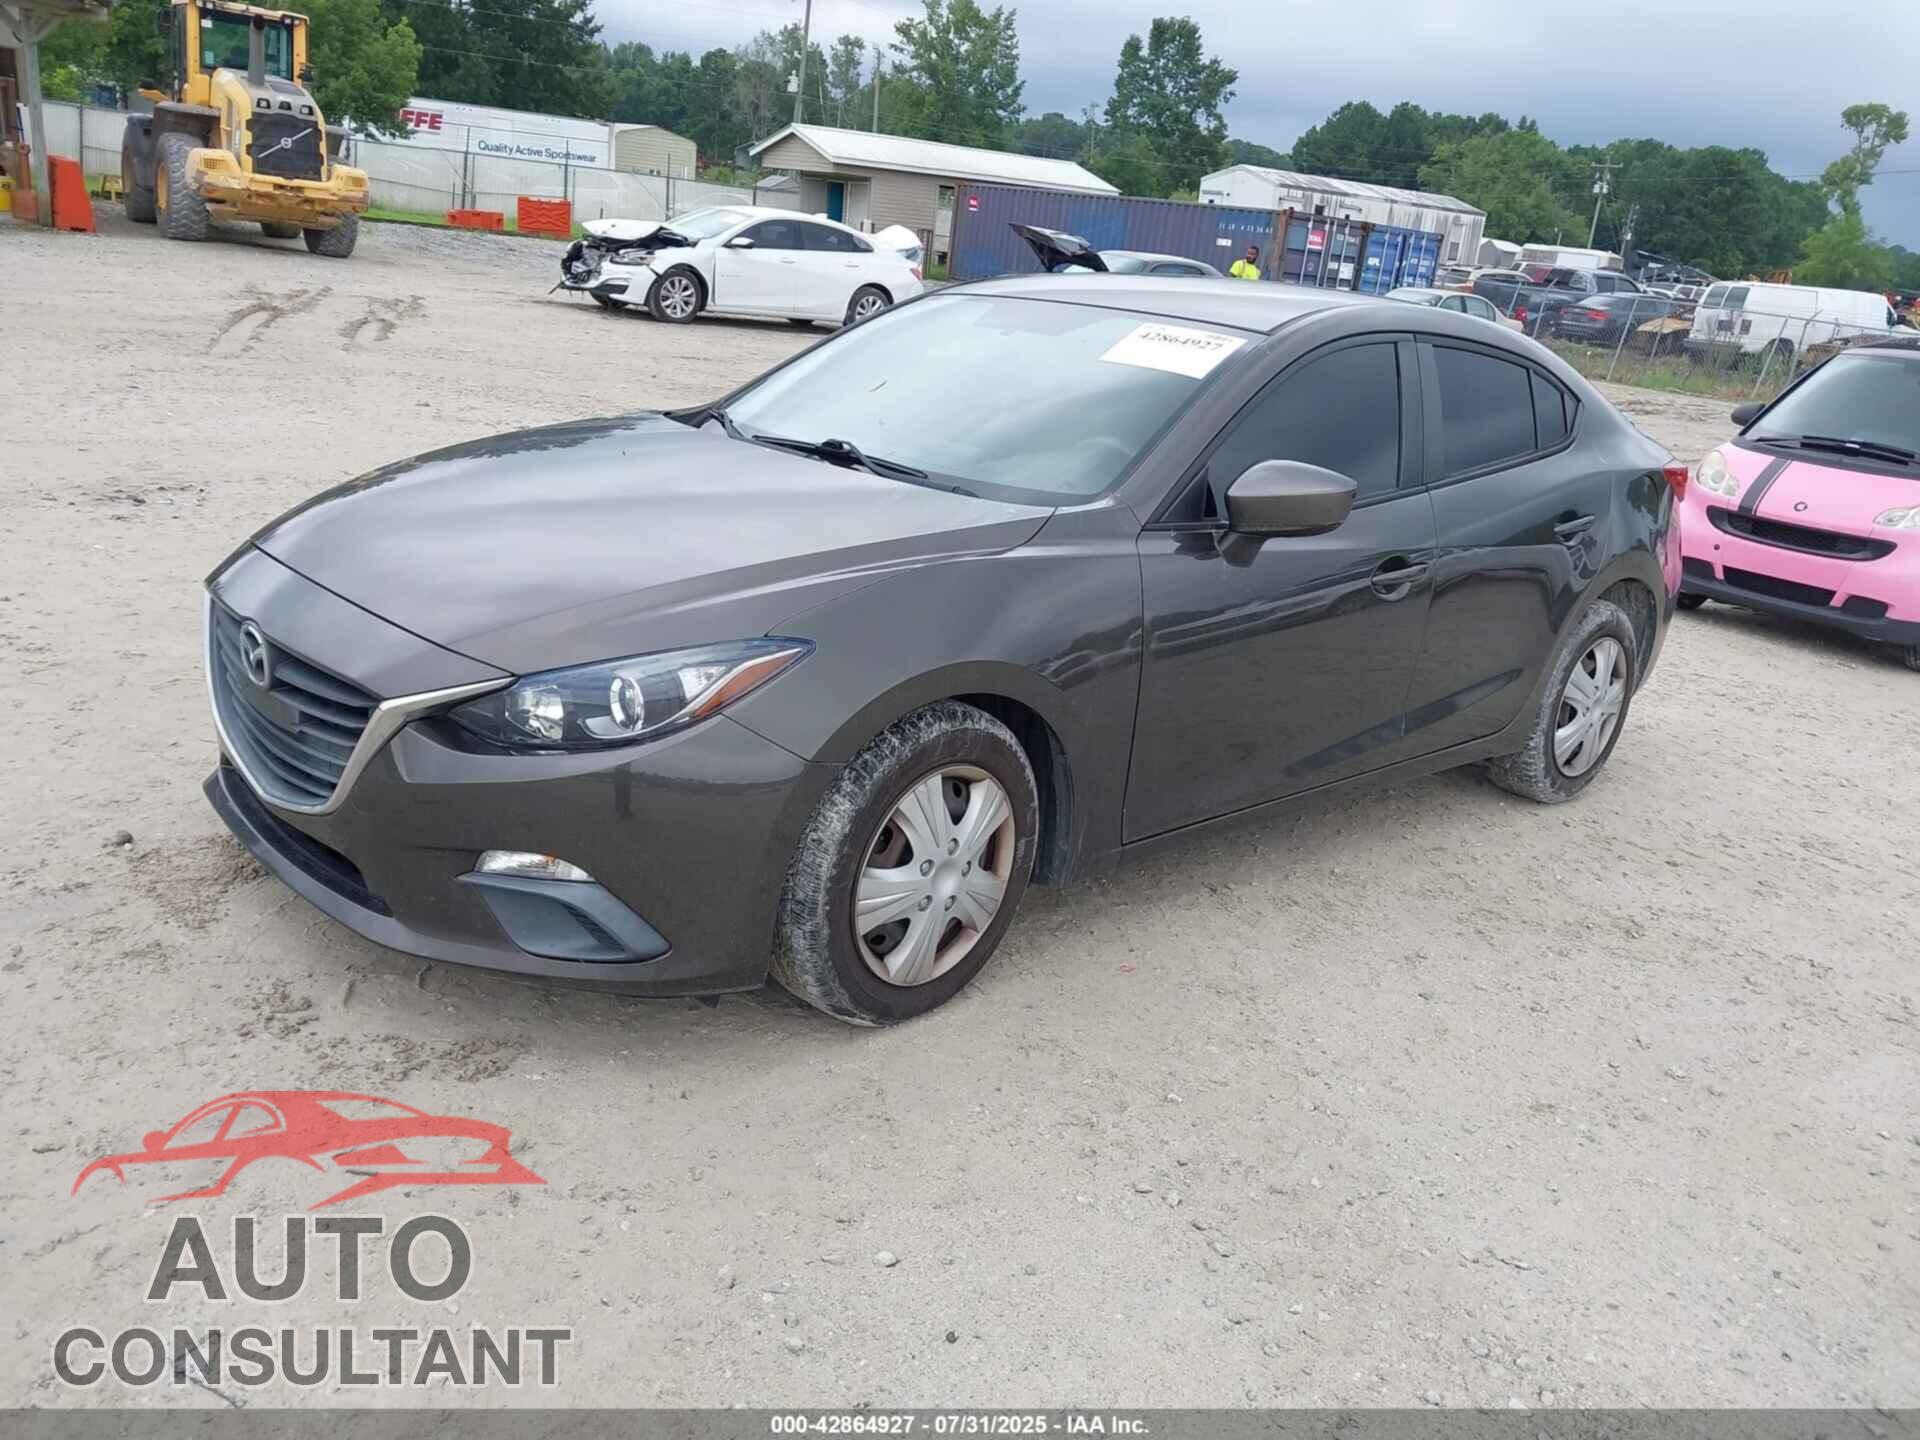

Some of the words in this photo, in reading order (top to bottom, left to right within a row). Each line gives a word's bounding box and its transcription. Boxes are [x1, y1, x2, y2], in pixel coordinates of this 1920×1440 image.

[401, 110, 443, 130] FFE
[478, 140, 514, 155] Quality
[515, 145, 543, 157] Active
